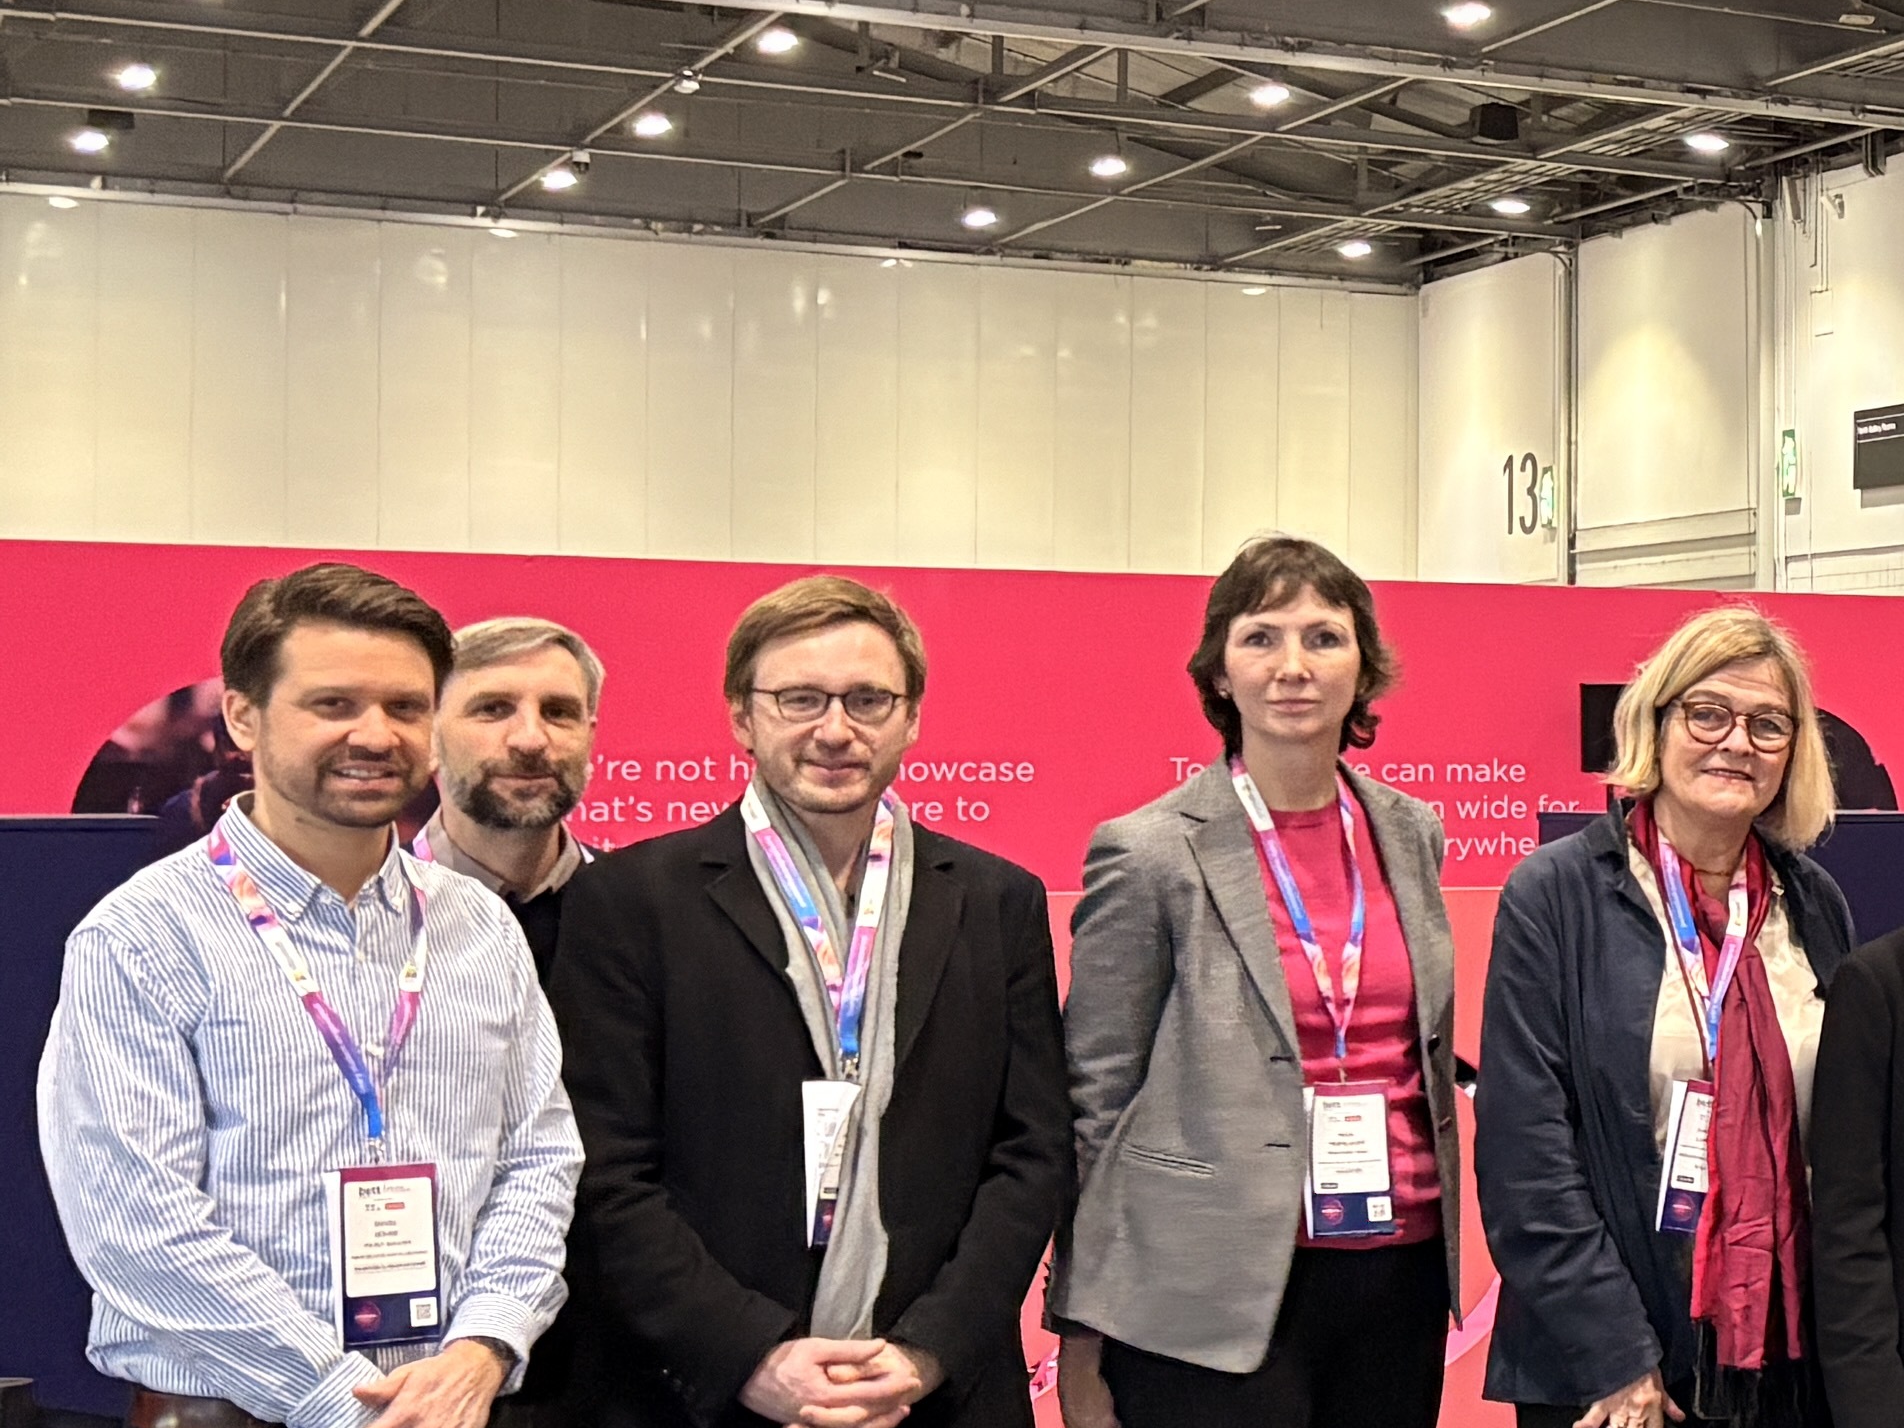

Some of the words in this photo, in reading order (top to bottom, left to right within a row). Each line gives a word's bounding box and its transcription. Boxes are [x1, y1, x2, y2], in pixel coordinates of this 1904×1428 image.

[1503, 452, 1538, 535] 13
[655, 756, 716, 781] not
[729, 754, 750, 781] h
[1381, 762, 1434, 783] can
[1446, 757, 1526, 783] make
[904, 800, 944, 822] re
[956, 795, 990, 822] to
[1456, 795, 1527, 820] wide
[1444, 831, 1537, 861] rywhe
